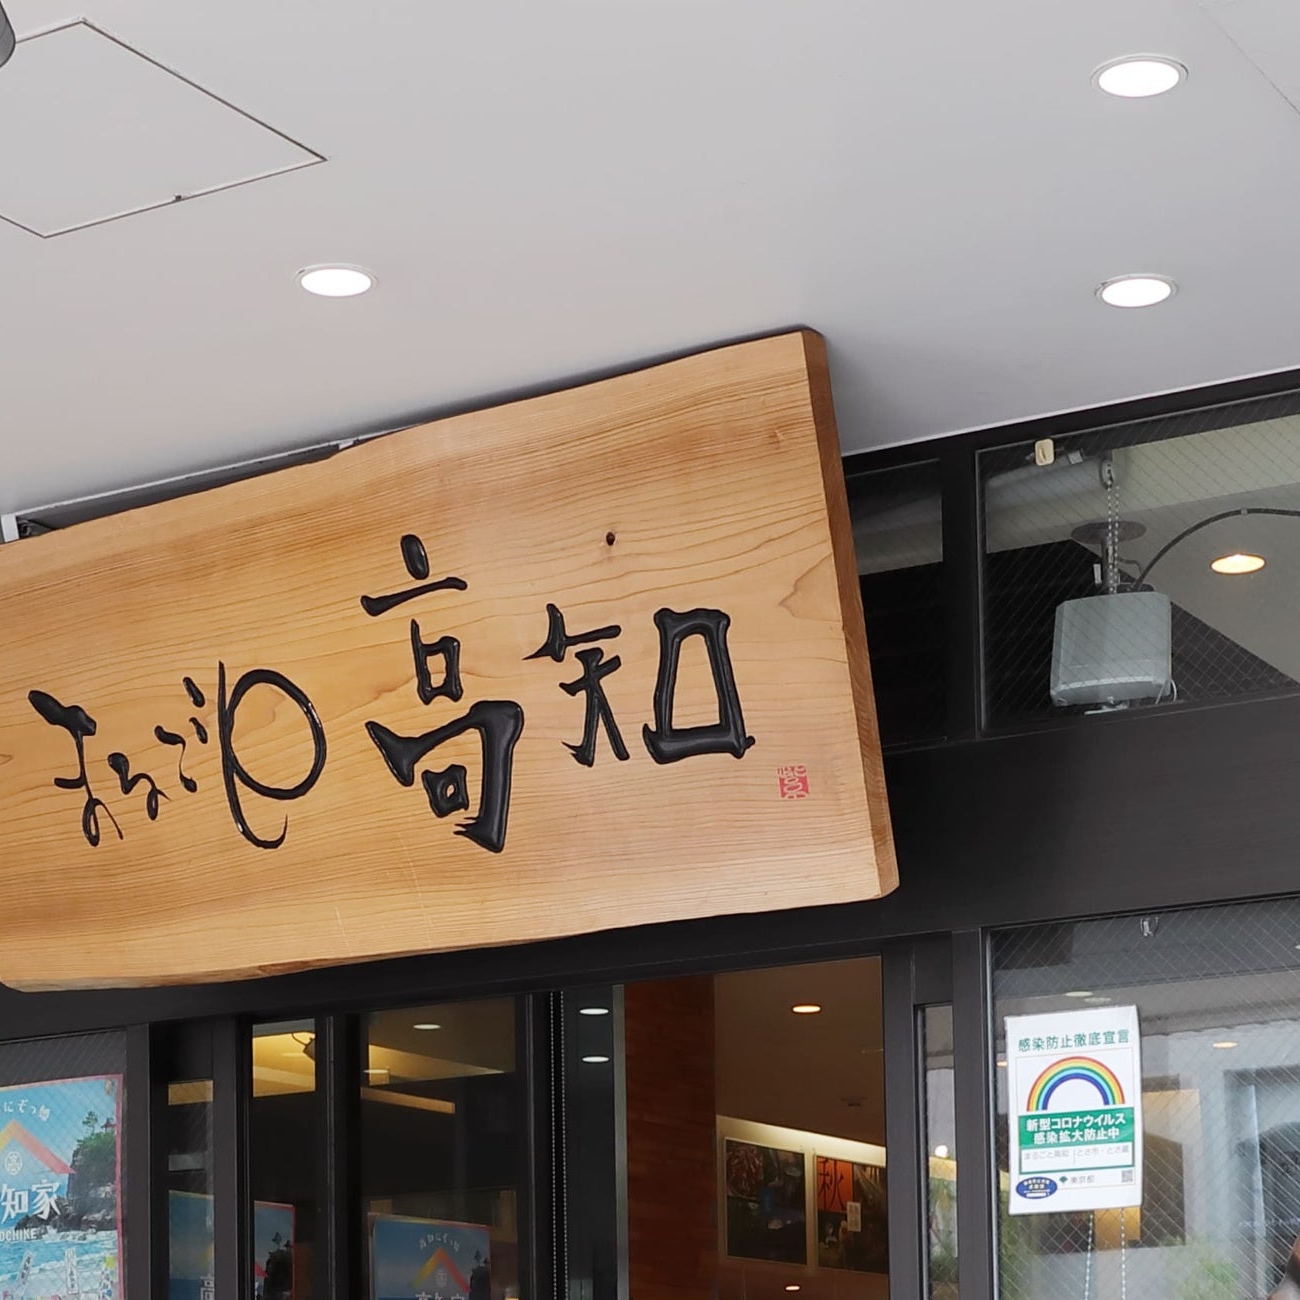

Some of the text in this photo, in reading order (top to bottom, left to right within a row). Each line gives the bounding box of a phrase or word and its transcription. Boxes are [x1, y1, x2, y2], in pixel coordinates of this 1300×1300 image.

[1018, 1029, 1130, 1053] 感染防止徹底宣言
[1026, 1113, 1127, 1132] 新型コロナウイルス
[1033, 1128, 1121, 1146] 感染拡大防止中
[818, 1157, 846, 1212] 秋
